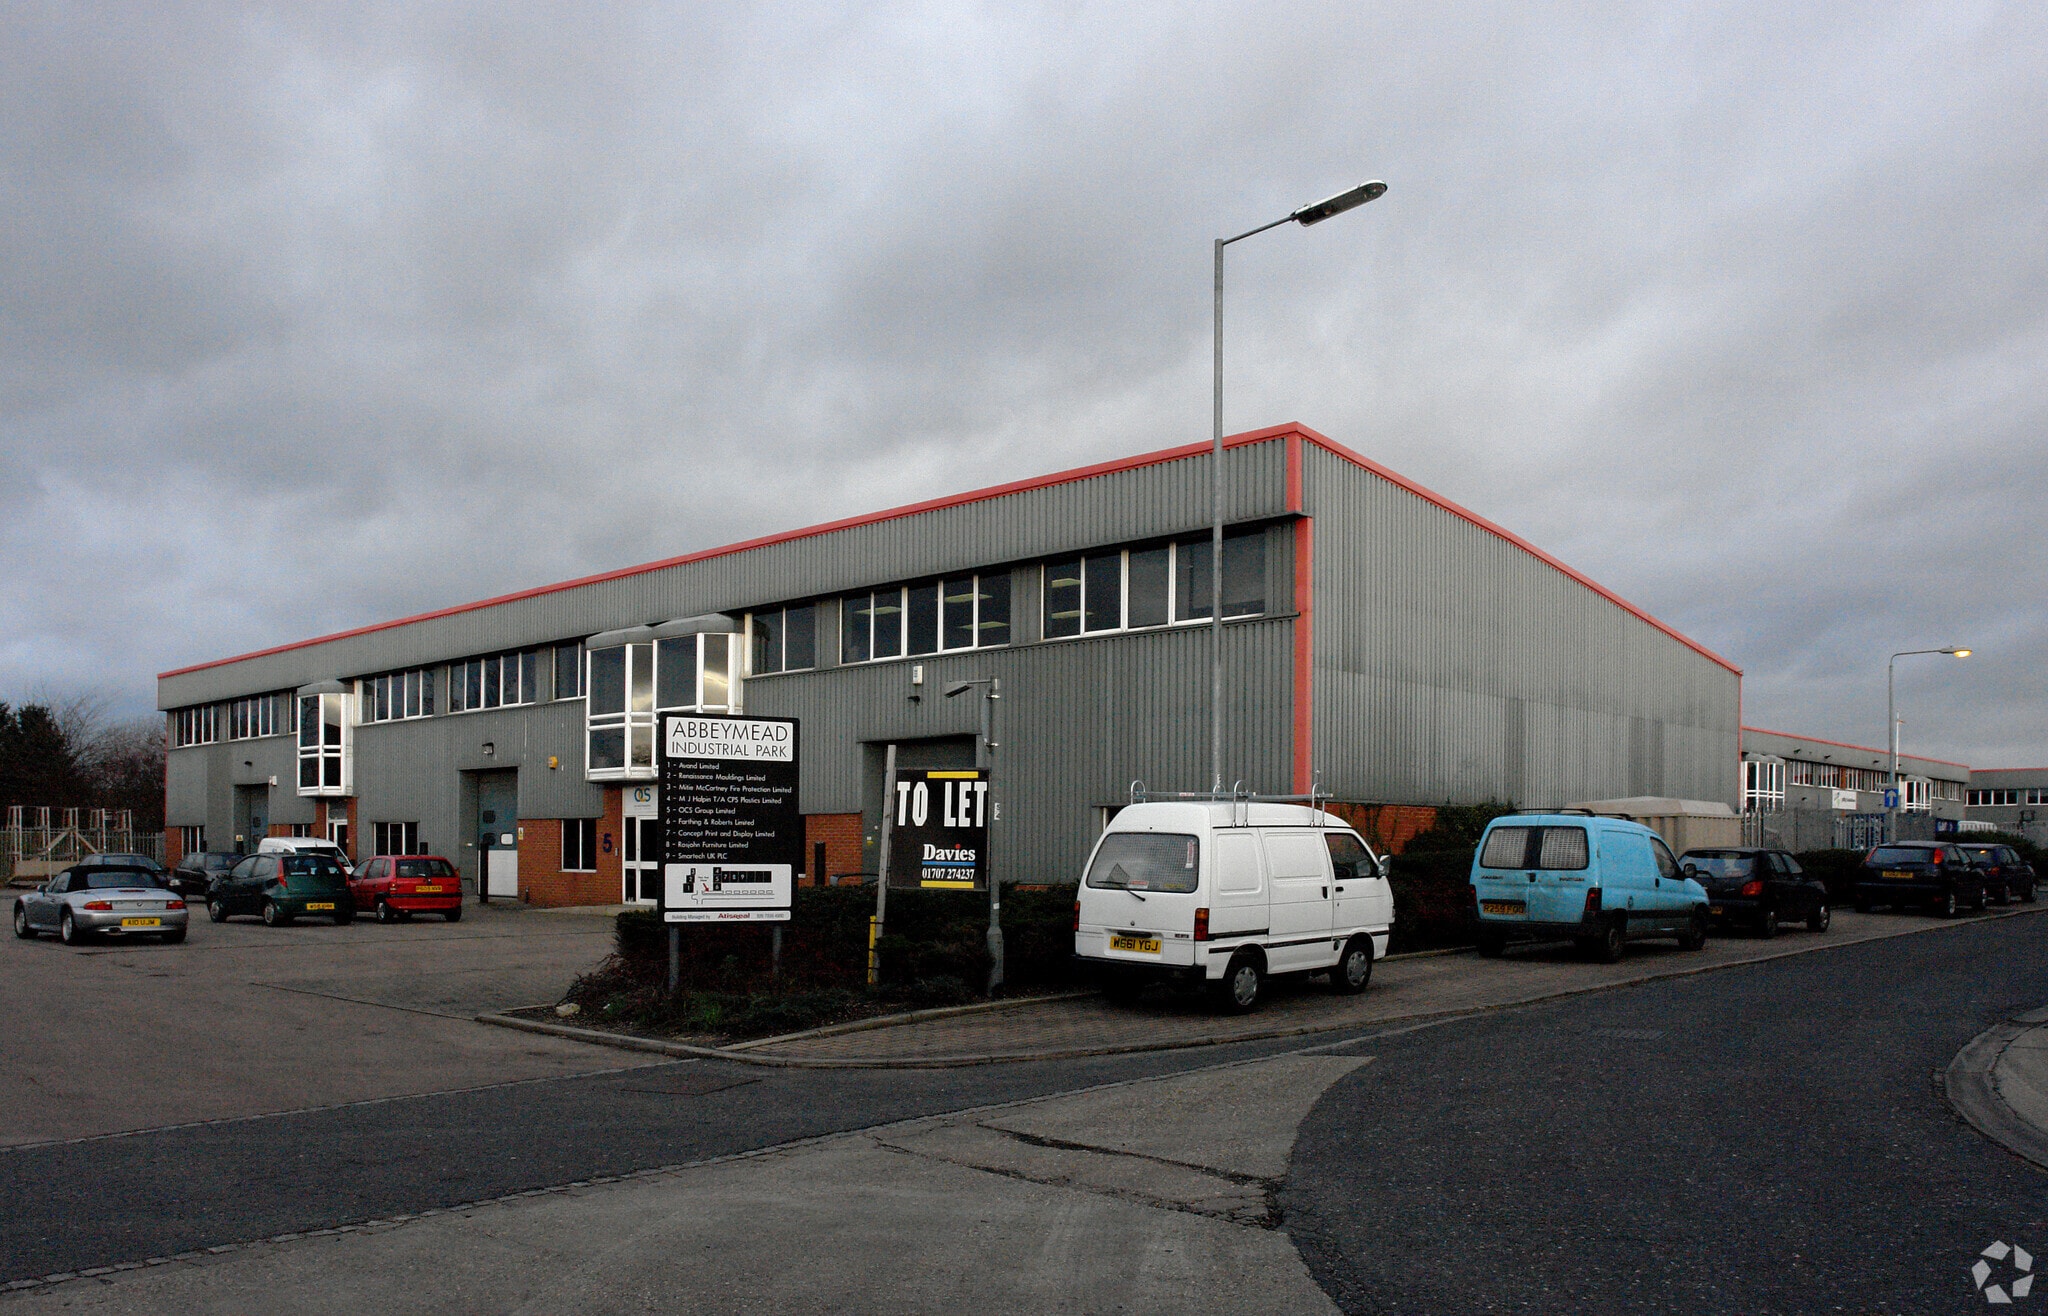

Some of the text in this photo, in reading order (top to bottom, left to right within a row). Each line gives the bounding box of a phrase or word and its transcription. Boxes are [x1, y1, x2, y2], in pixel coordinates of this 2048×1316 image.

[672, 721, 788, 742] ABBEYMEAD
[671, 741, 787, 758] INDUSTRIAL PARK
[716, 774, 744, 782] Mouldings
[897, 782, 988, 827] TO LET
[678, 818, 702, 826] Farthing
[602, 833, 612, 853] 5
[922, 844, 976, 861] Davies
[922, 868, 975, 880] 01707 274237
[1138, 940, 1158, 951] YGJ
